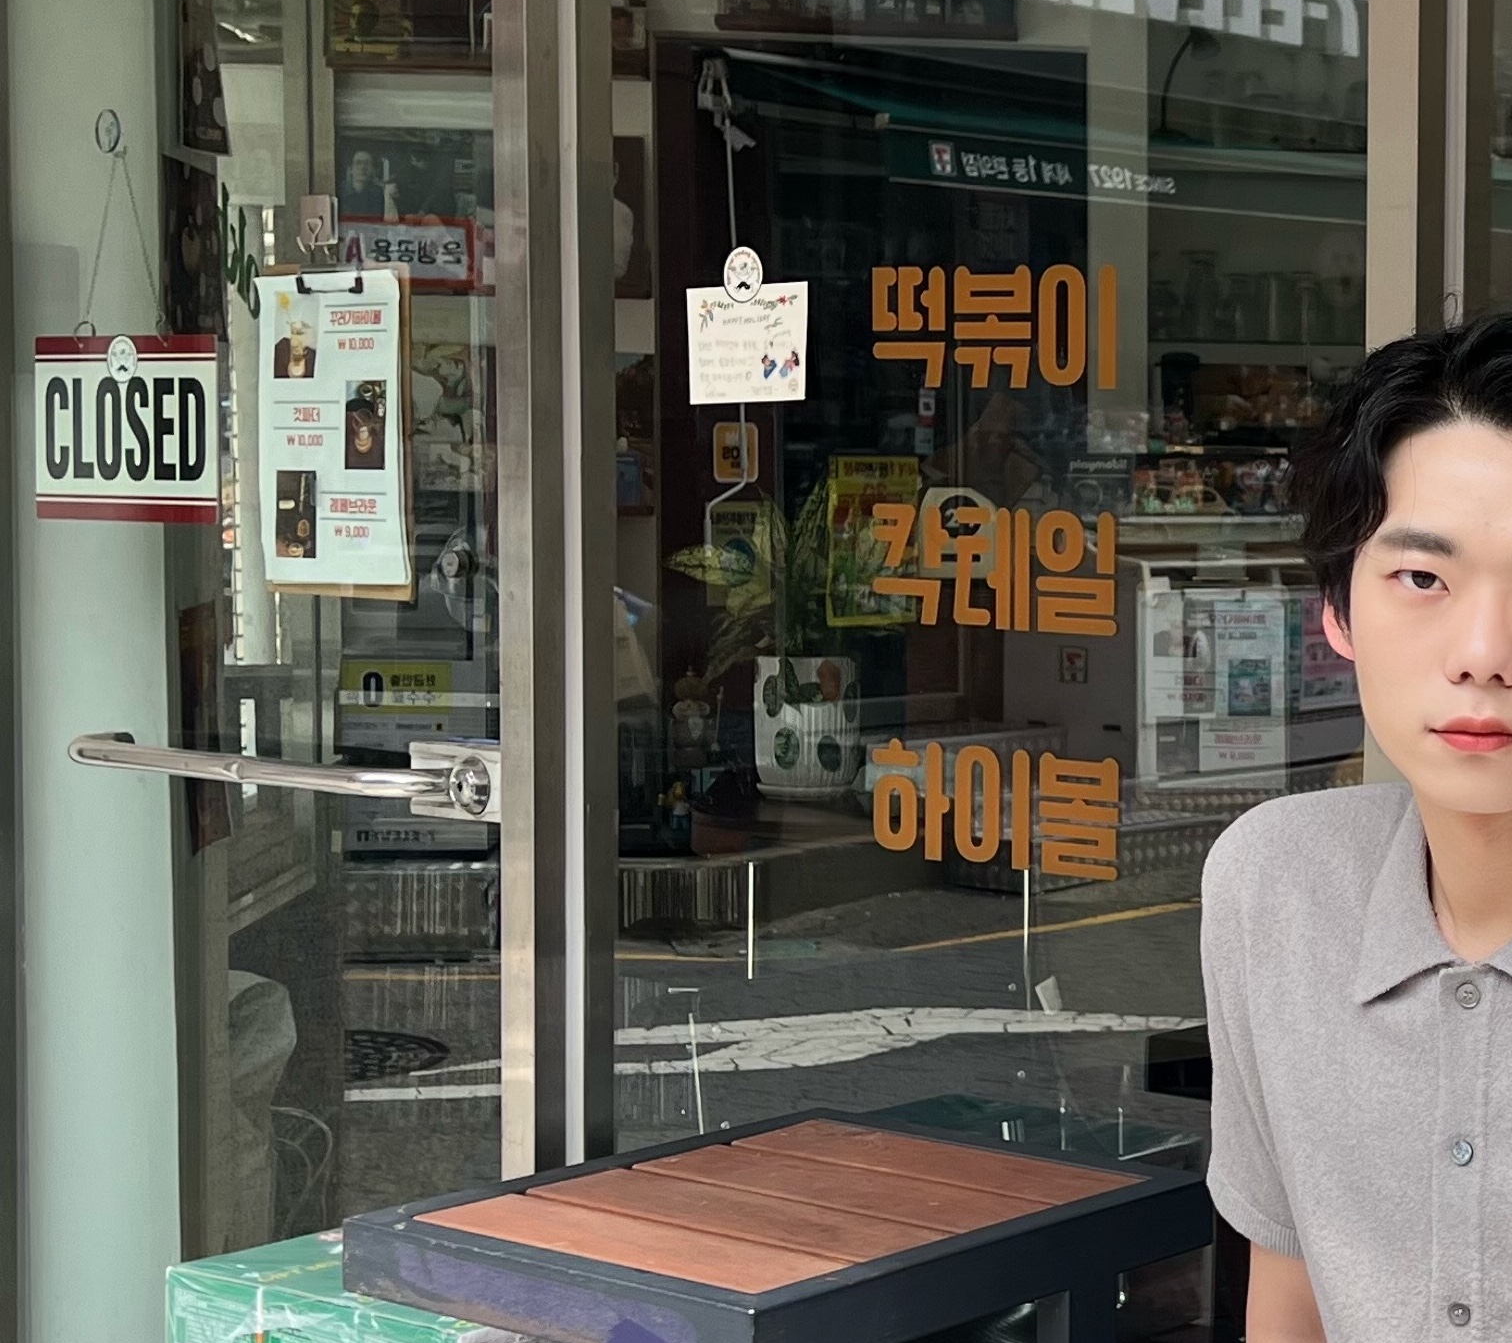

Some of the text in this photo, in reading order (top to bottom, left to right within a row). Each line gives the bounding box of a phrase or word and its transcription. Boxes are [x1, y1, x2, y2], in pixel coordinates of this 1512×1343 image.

[871, 264, 1118, 391] 떡볶이
[45, 376, 206, 482] CLOSED
[872, 503, 1119, 637] 칵테일
[872, 738, 1122, 882] 하이볼
